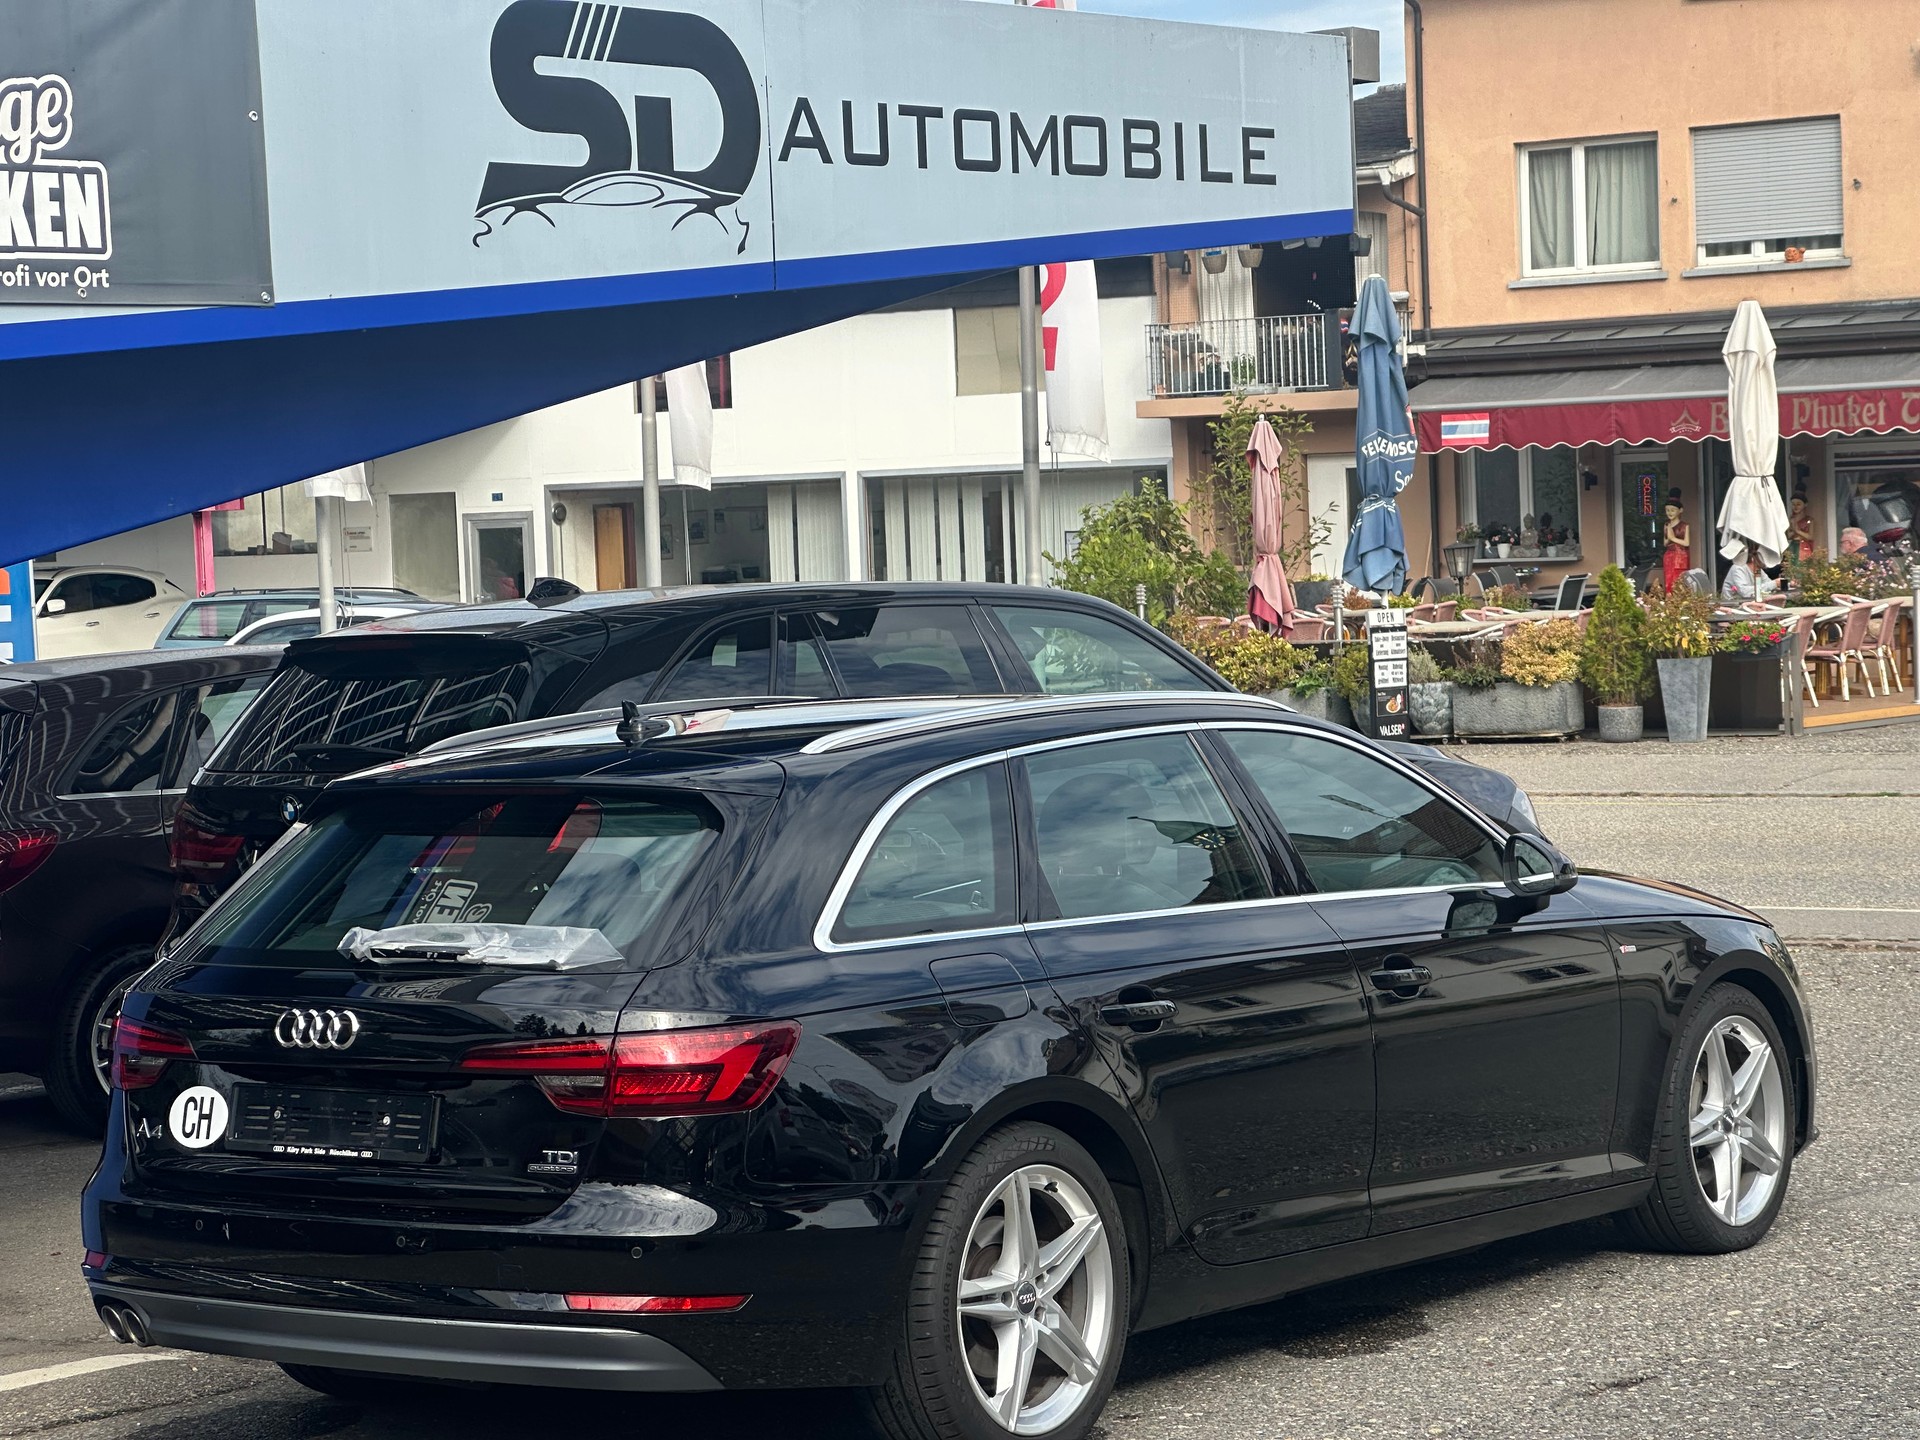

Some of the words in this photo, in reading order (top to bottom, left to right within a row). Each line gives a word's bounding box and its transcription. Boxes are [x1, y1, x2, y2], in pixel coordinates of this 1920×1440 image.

[476, 0, 761, 206] SD
[778, 96, 1277, 186] AUTOMOBILE
[0, 170, 102, 249] KEN
[34, 271, 69, 287] vor
[74, 266, 110, 288] Ort
[1792, 395, 1887, 431] Phuket
[1643, 477, 1652, 515] OPEN
[1377, 612, 1395, 623] OPEN
[1380, 724, 1403, 737] VALSER
[137, 1118, 162, 1138] A4
[181, 1096, 215, 1140] CH
[543, 1150, 578, 1164] TDI
